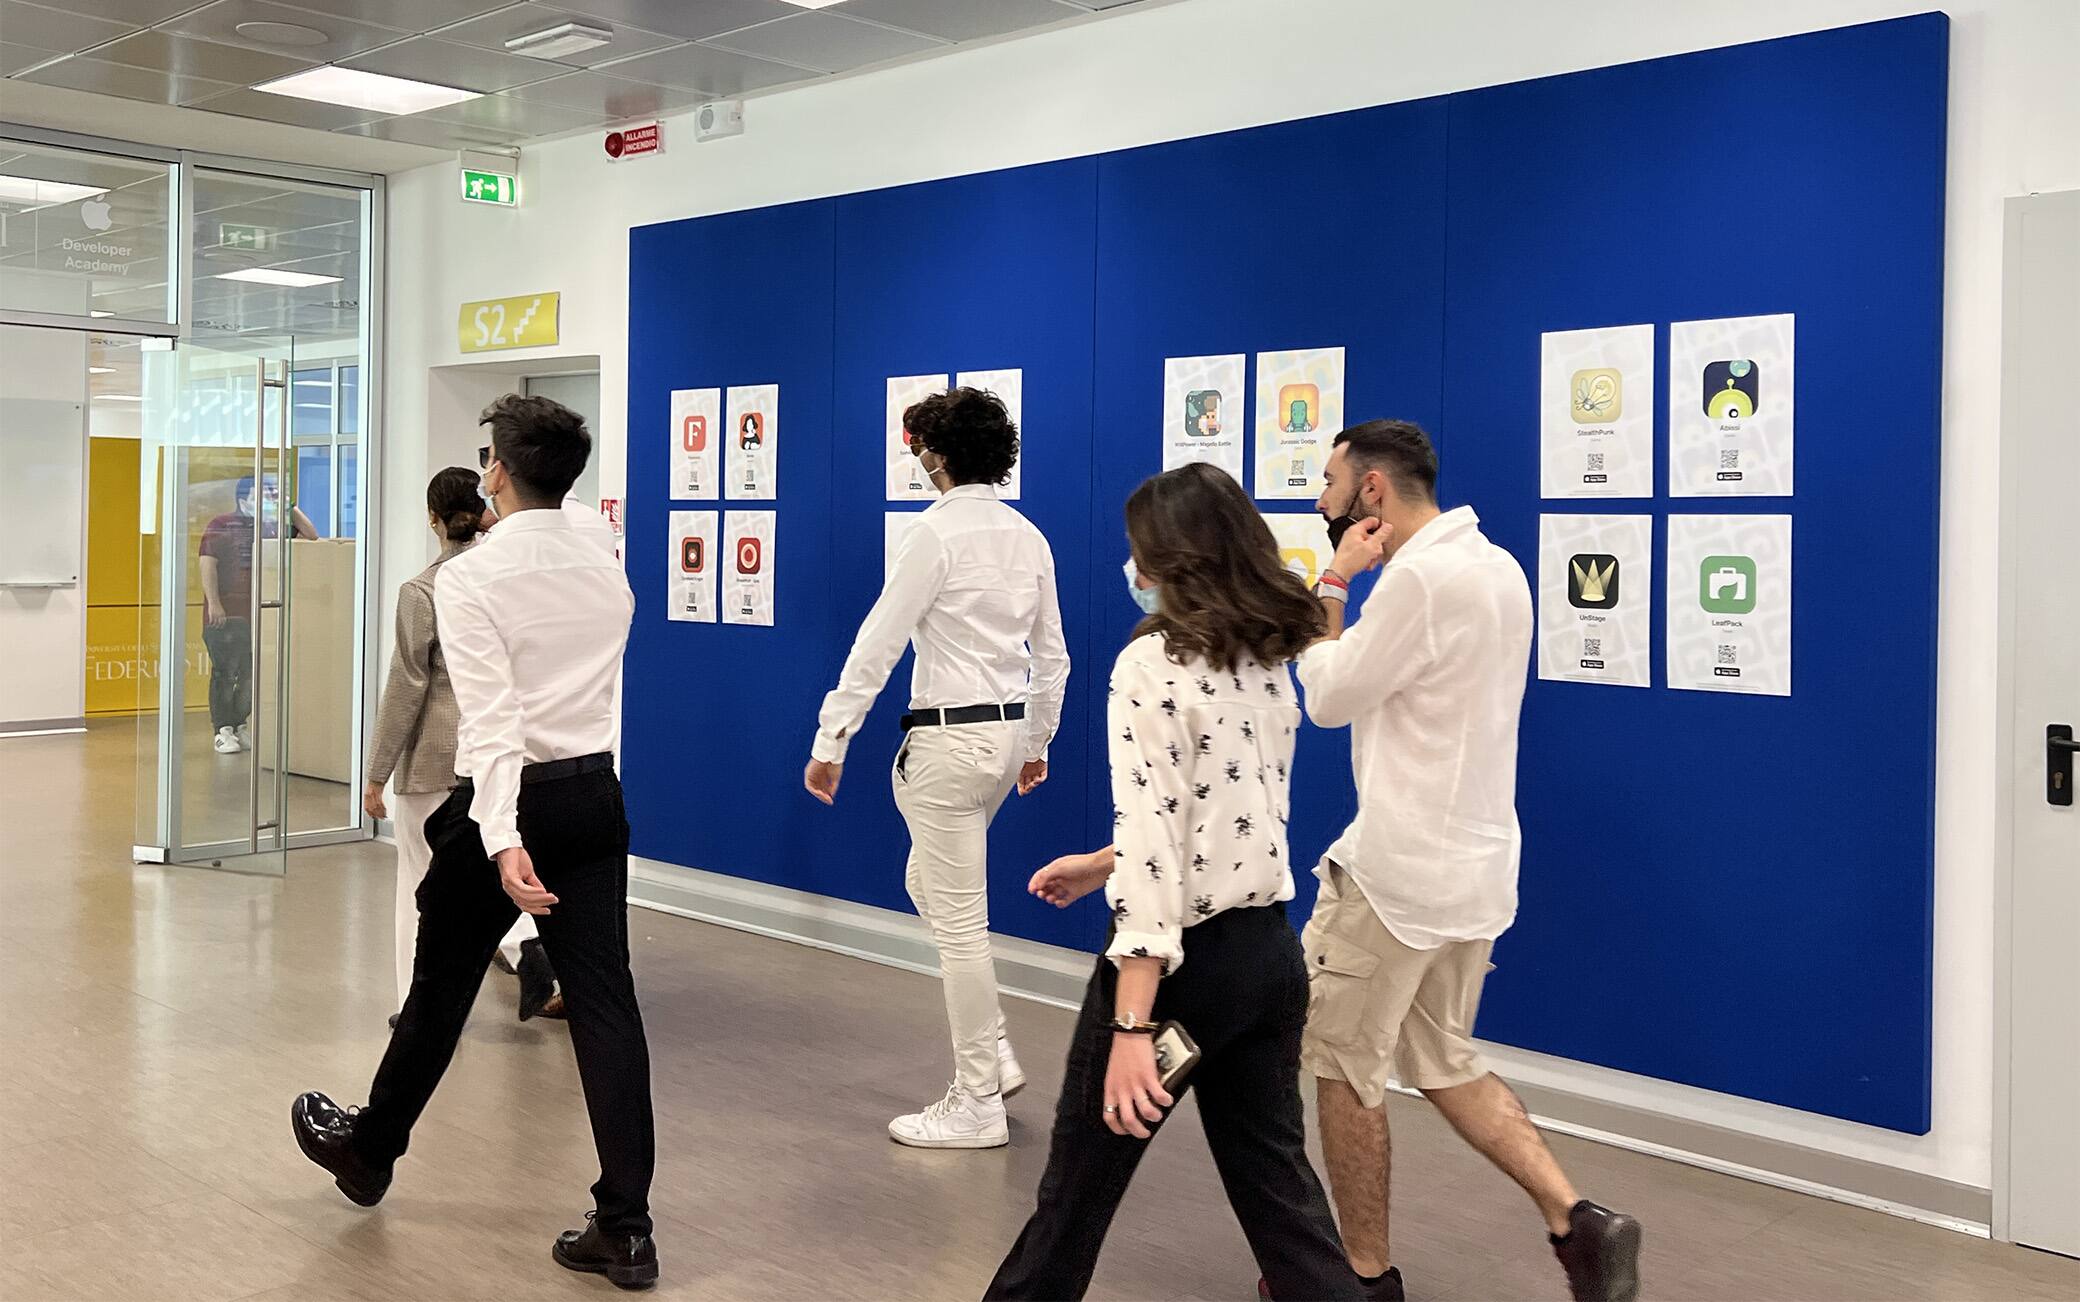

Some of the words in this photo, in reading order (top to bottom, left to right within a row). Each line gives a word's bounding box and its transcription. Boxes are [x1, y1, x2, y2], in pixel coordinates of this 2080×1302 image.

[625, 128, 656, 142] ALLARME
[625, 139, 656, 152] INCENDIO
[62, 238, 132, 257] Developer
[64, 255, 129, 275] Academy
[475, 304, 506, 347] S2
[1579, 614, 1606, 623] UnStage
